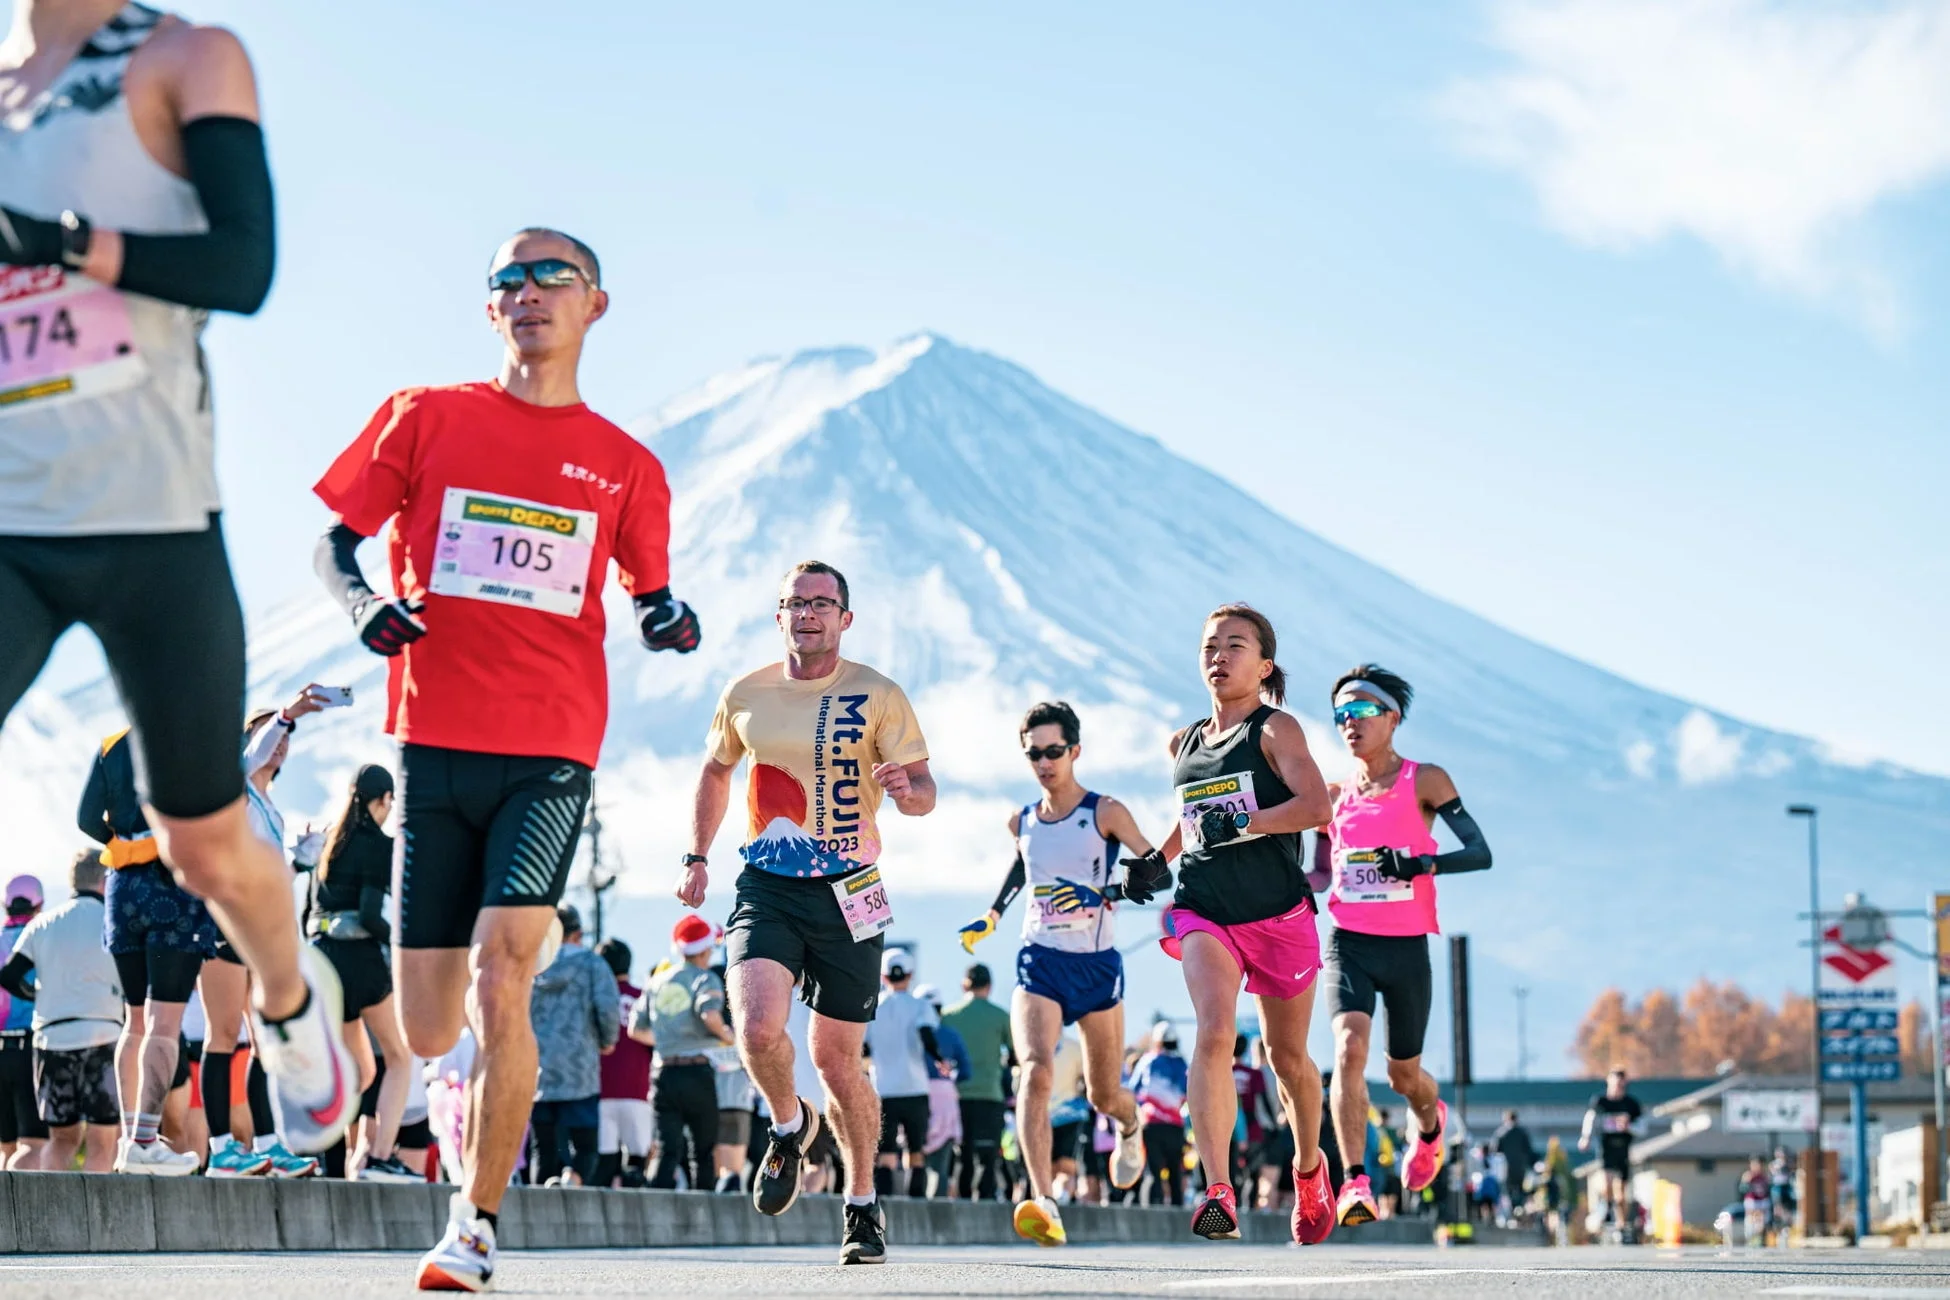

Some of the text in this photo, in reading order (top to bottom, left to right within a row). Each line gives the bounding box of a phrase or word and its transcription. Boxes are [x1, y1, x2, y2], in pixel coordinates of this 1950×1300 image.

[510, 506, 573, 532] DEPO
[492, 536, 554, 572] 105
[815, 695, 833, 836] International Marathon
[1206, 780, 1237, 795] DEPO
[819, 836, 859, 854] 2023
